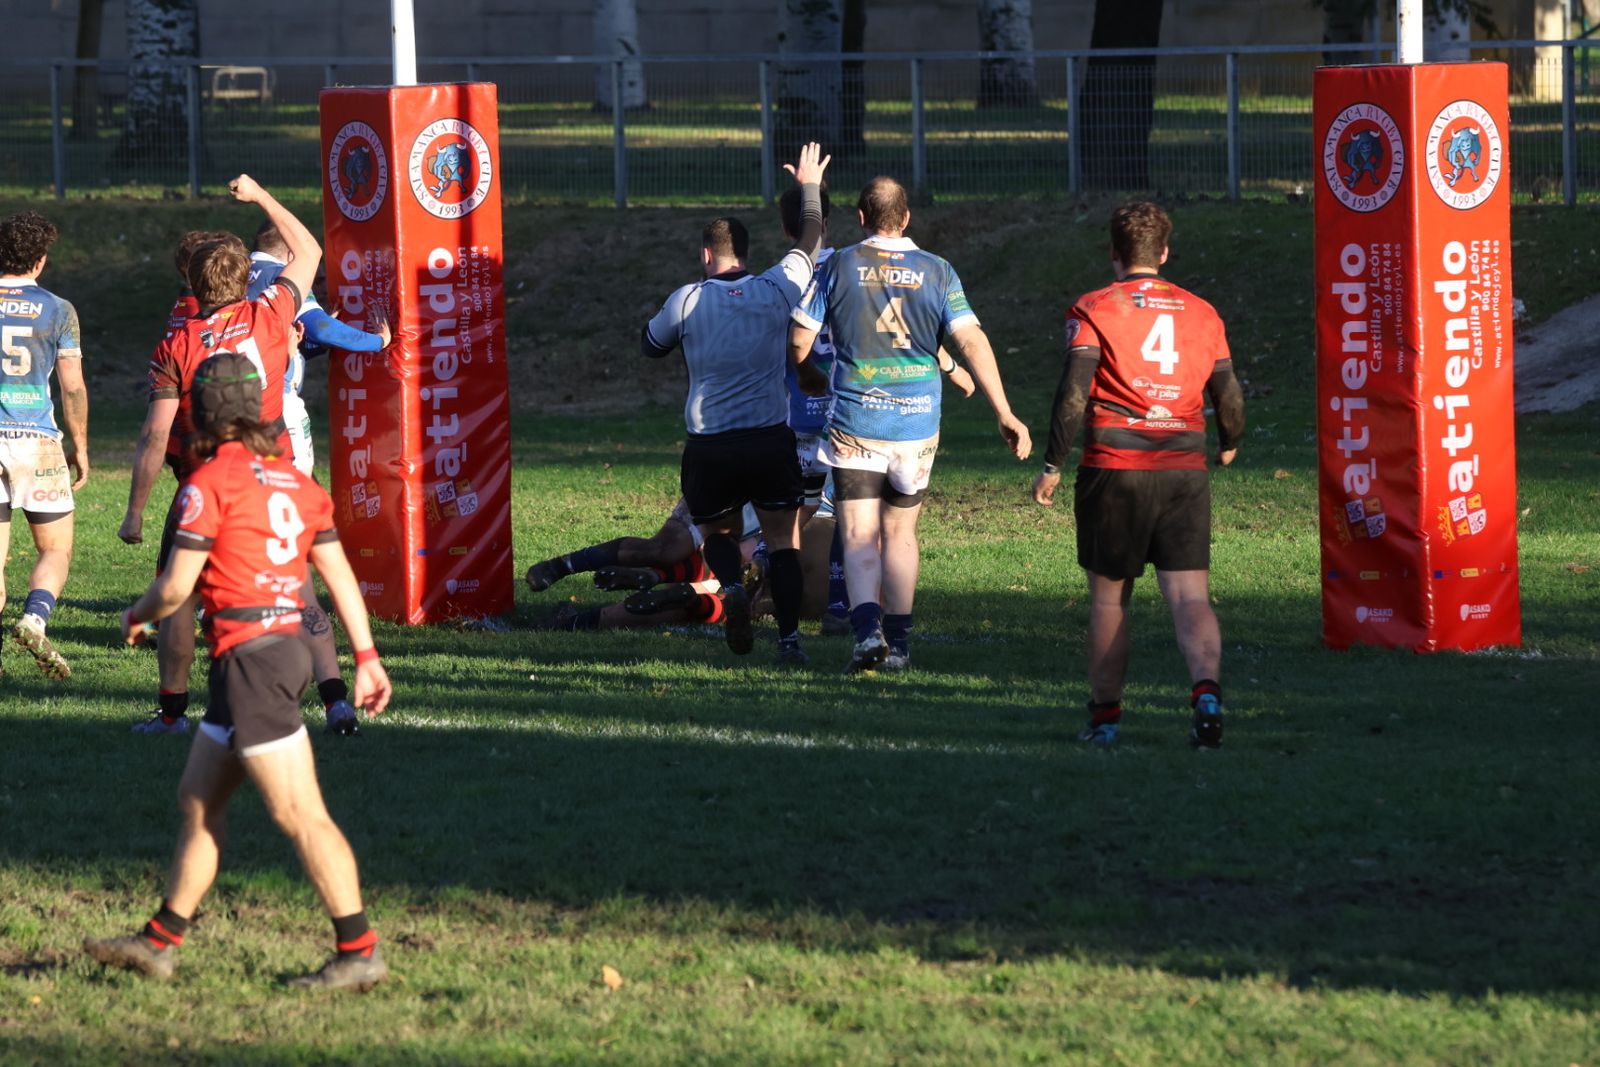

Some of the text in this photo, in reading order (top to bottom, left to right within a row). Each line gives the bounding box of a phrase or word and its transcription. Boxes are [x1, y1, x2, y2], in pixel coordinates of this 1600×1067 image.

[349, 207, 371, 219] 1993
[439, 204, 464, 216] 1993
[1351, 196, 1378, 210] 1993
[1452, 193, 1477, 207] 1993
[363, 249, 374, 291] León
[471, 245, 482, 312] 900 84 74 84
[857, 266, 925, 285] TANDEN
[1382, 243, 1393, 315] 900 84 74 84
[1481, 239, 1491, 312] 900 84 74 84
[456, 246, 472, 364] Castilla y León
[875, 296, 912, 350] 4
[1369, 243, 1383, 373] Castilla y León
[1392, 243, 1404, 374] www.atiendojcyl.es
[1469, 240, 1483, 369] Castilla y León
[1491, 240, 1503, 369] www.atiendojcyl.es
[2, 325, 33, 376] 5
[420, 247, 467, 477] atiendo
[1140, 313, 1180, 375] 4
[1331, 243, 1376, 496] atiendo
[1433, 241, 1479, 493] atiendo
[862, 395, 931, 405] PATRIMONIO
[900, 404, 932, 415] global
[265, 491, 306, 566] 9
